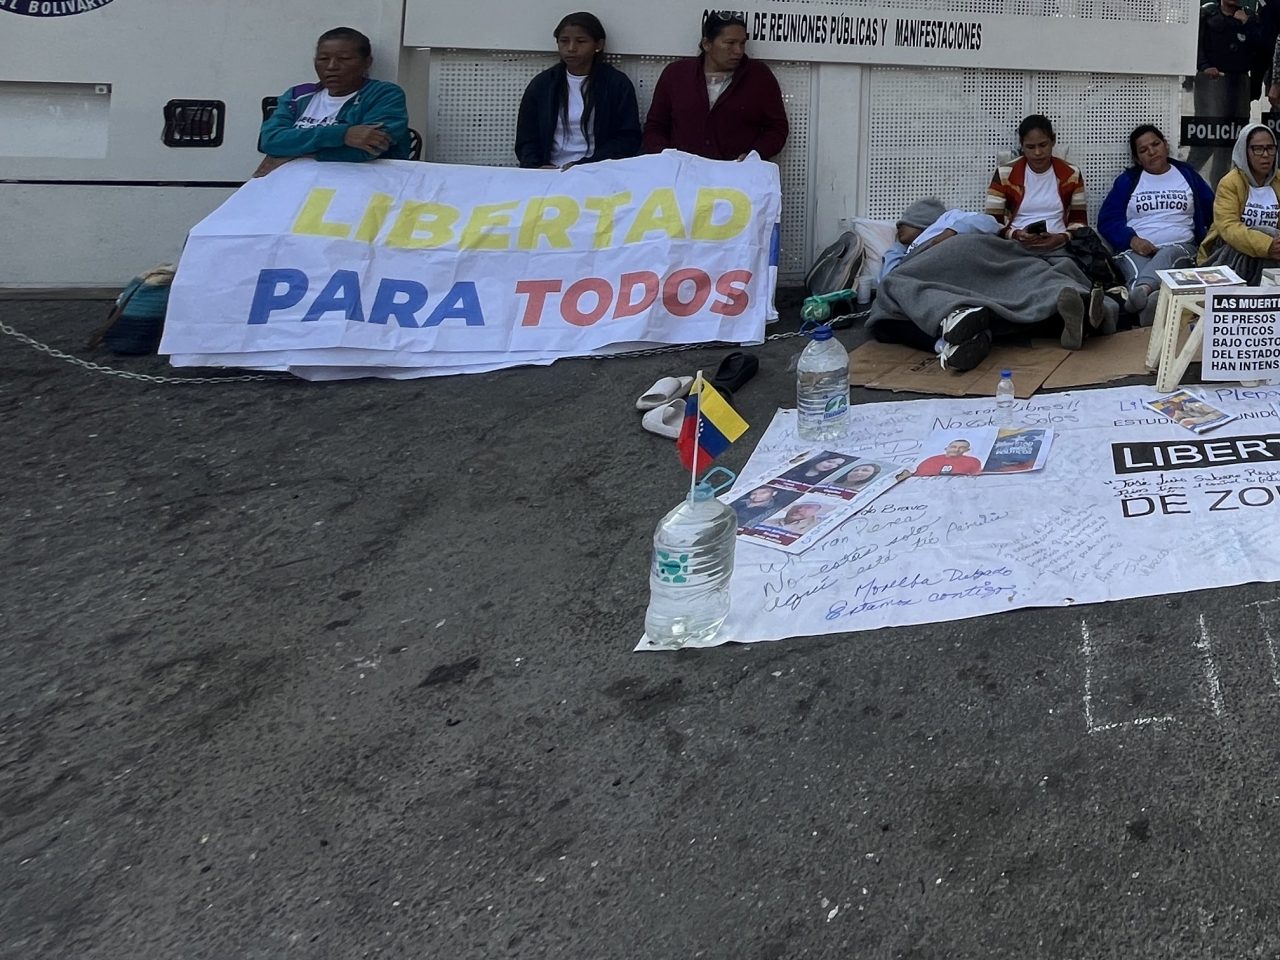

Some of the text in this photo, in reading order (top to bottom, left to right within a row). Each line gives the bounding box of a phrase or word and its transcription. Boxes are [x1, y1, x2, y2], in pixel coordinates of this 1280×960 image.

[753, 11, 767, 40] DE
[769, 12, 828, 43] REUNIONES
[830, 12, 878, 46] PÚBLICAS
[878, 18, 887, 46] Y
[894, 18, 983, 51] MANIFESTACIONES
[1136, 193, 1188, 203] LOS PRESOS
[1136, 200, 1188, 213] POLÍTICOS
[292, 186, 755, 251] LIBERTAD
[1242, 209, 1259, 218] LOS
[247, 268, 753, 328] PARA TODOS
[1213, 298, 1237, 309] LAS
[1213, 314, 1276, 324] DE PRESOS
[1213, 324, 1274, 336] POLÍTICOS
[1212, 338, 1242, 348] BAJO
[1212, 350, 1233, 359] DEL
[1238, 349, 1280, 359] ESTADO
[1211, 361, 1236, 371] HAN
[1121, 493, 1191, 518] DE
